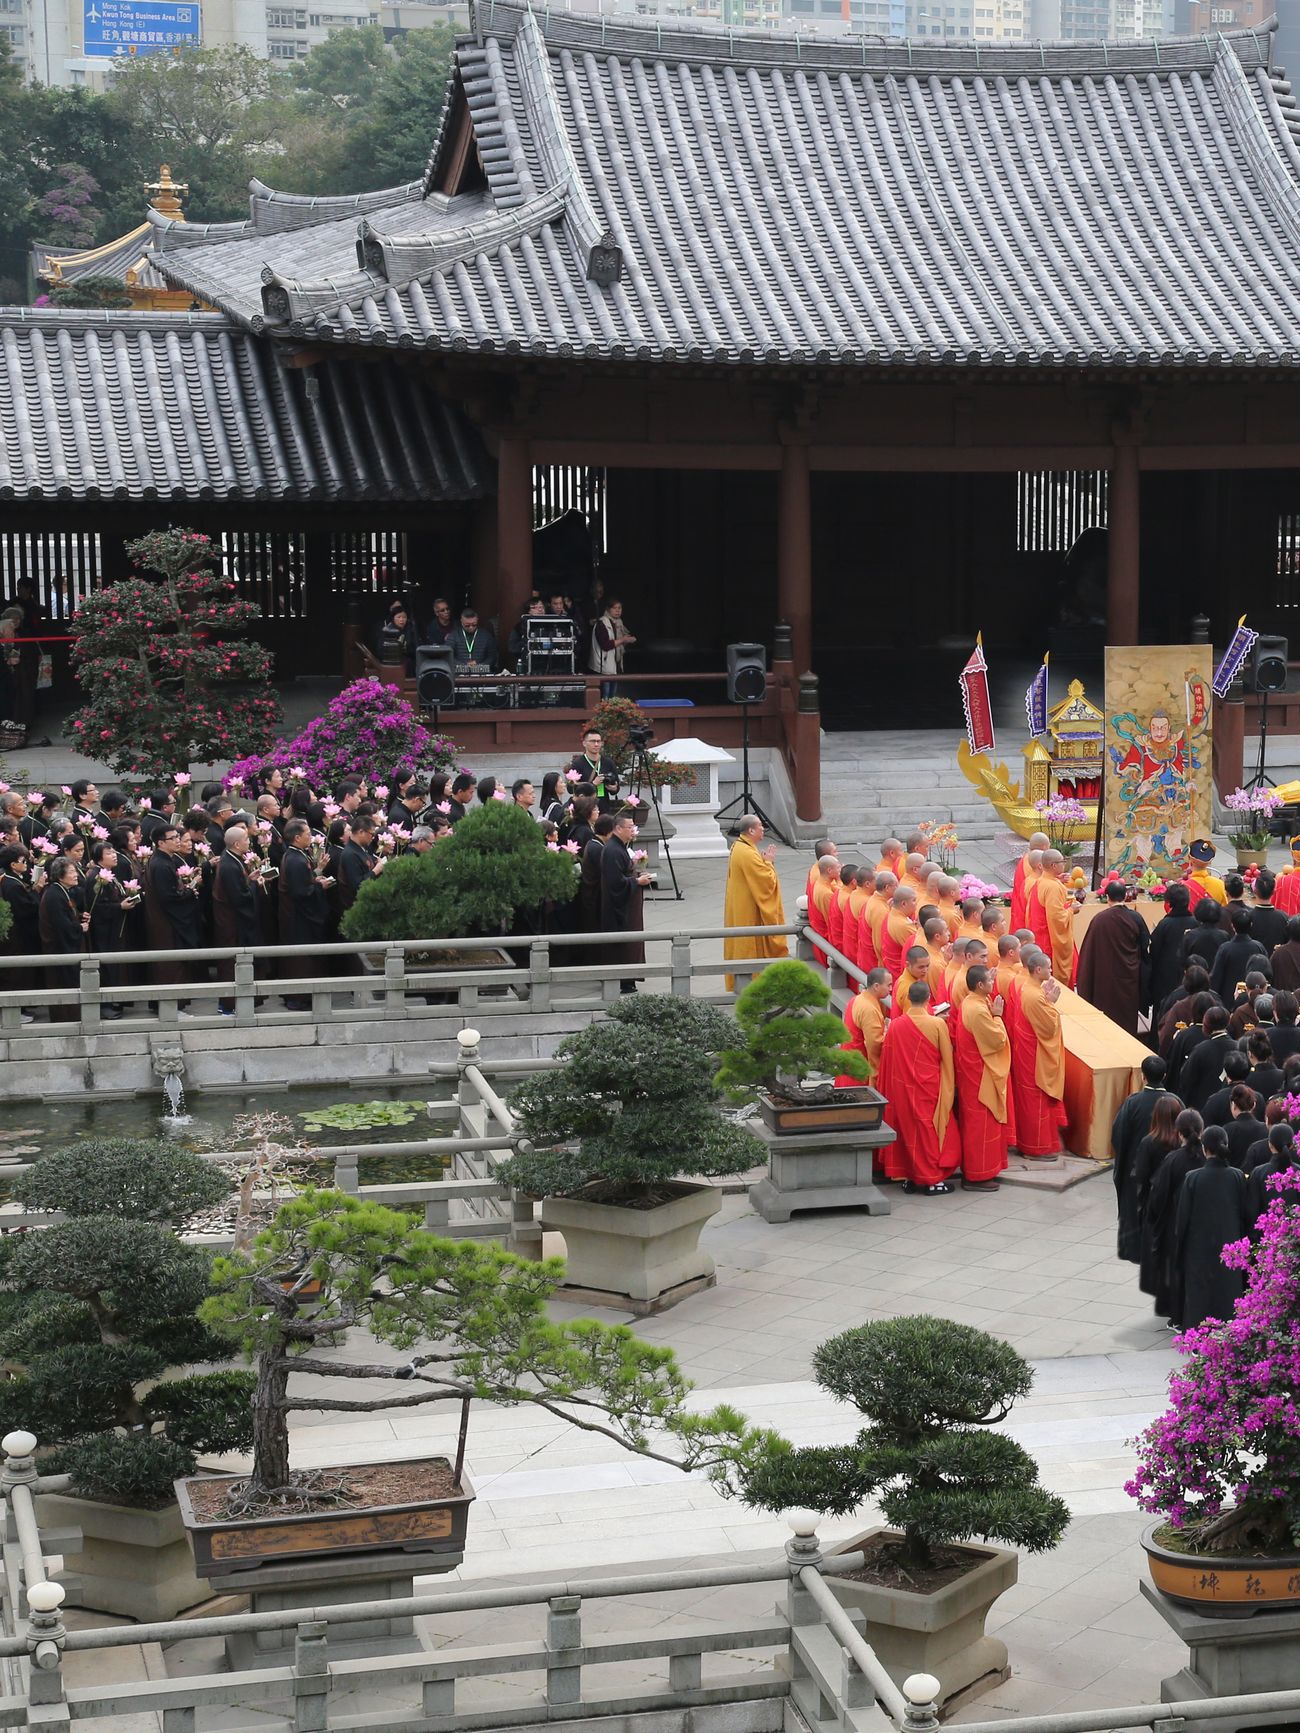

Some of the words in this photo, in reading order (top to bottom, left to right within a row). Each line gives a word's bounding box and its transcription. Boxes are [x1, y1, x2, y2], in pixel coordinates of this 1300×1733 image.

[102, 3, 117, 11] Mong
[120, 11, 134, 20] Tong
[102, 20, 117, 28] Hong
[120, 21, 134, 29] Kong
